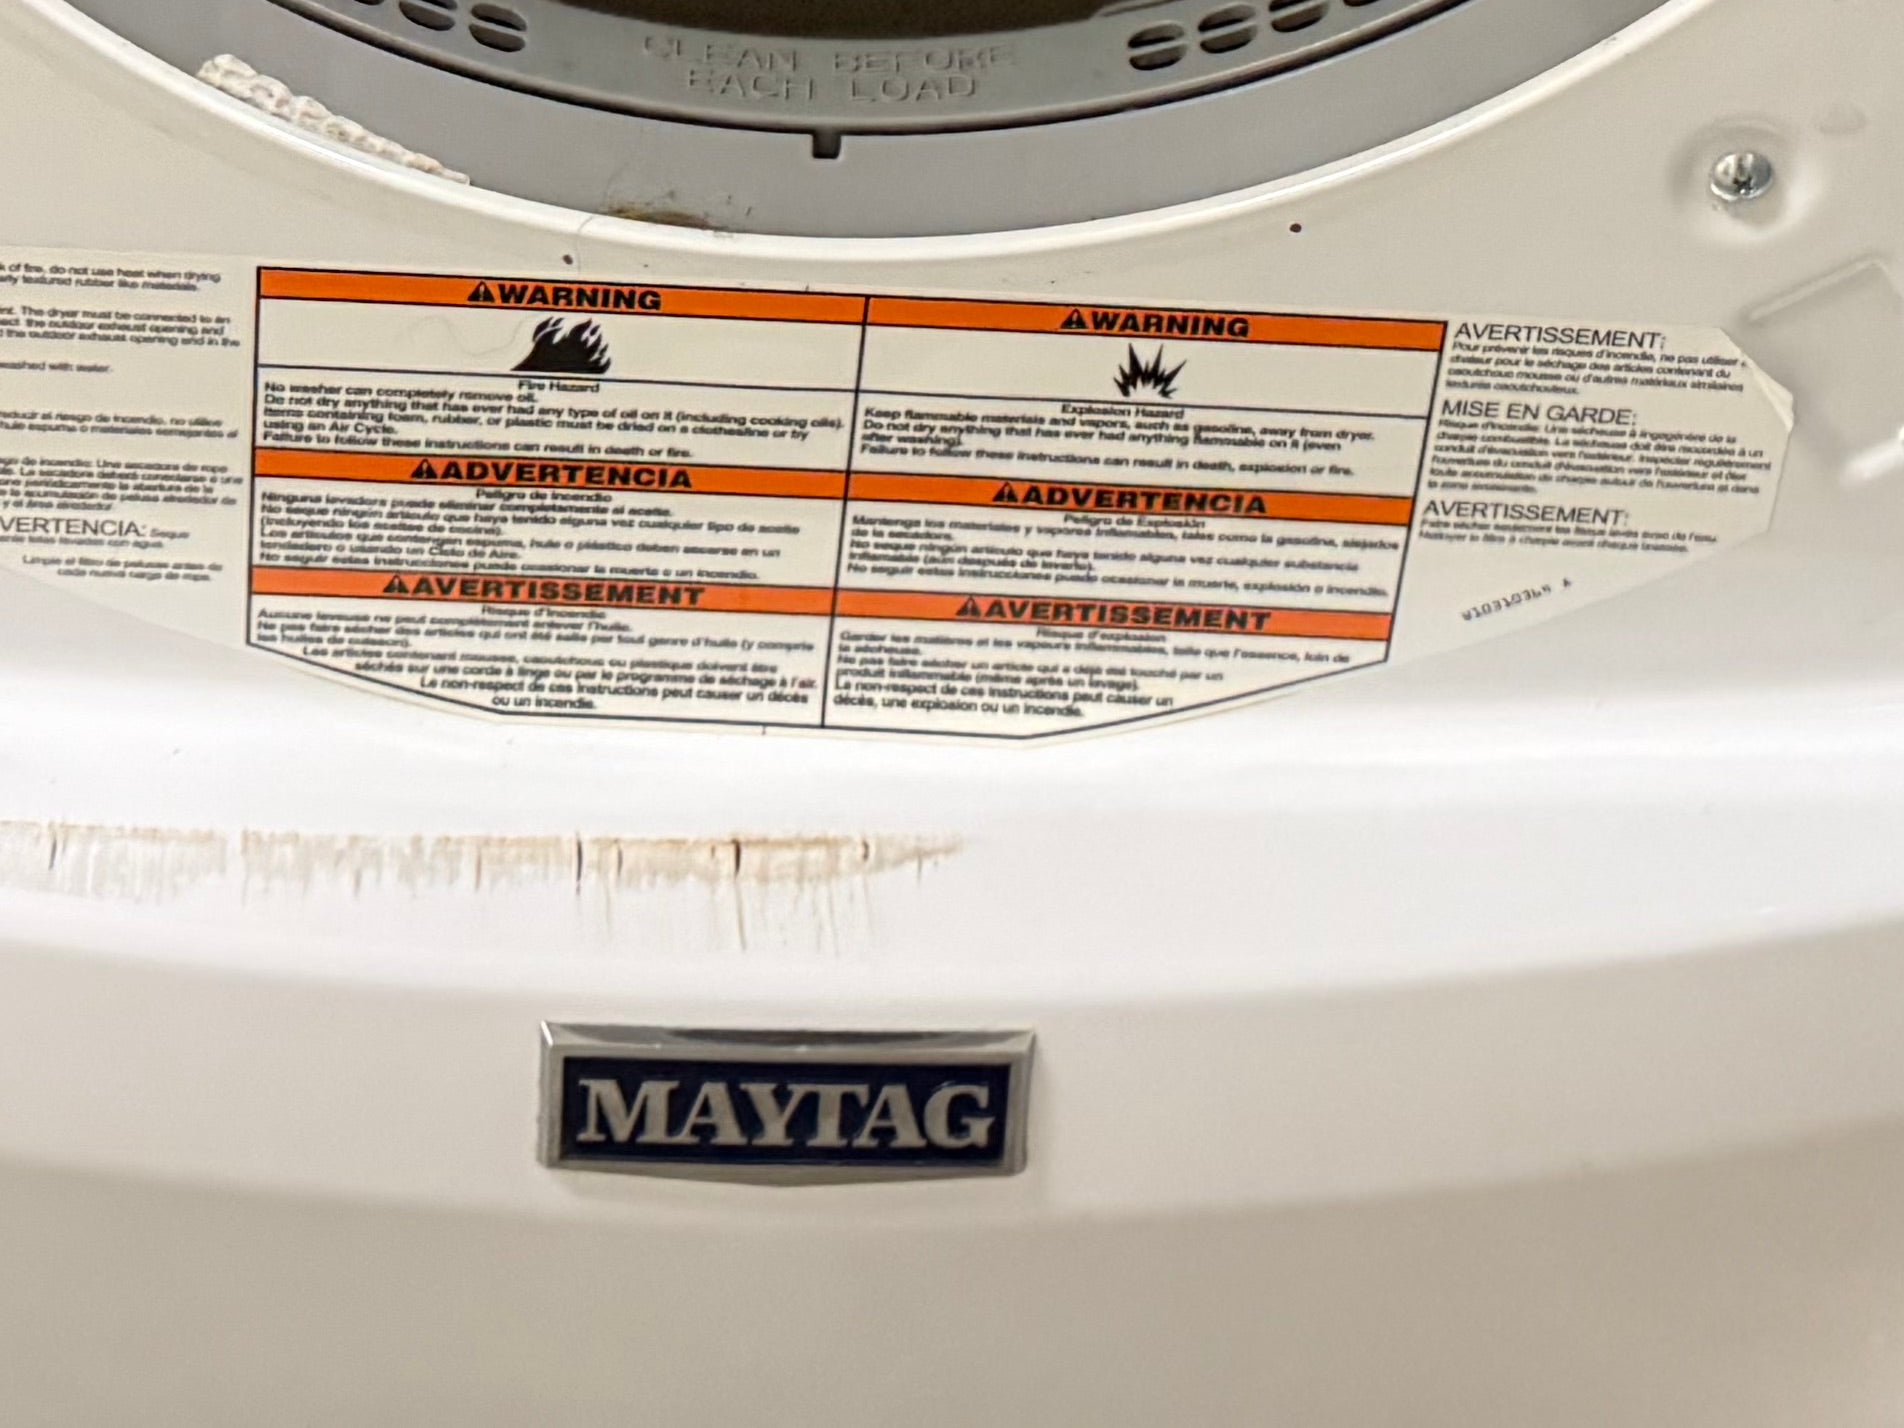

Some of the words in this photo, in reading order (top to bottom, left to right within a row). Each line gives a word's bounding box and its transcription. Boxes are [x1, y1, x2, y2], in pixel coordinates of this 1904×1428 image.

[644, 35, 798, 73] CLEAN
[833, 44, 1014, 74] BEFORE
[688, 67, 814, 101] EACH
[850, 73, 977, 103] LOAD
[498, 283, 663, 312] WARNING
[1091, 311, 1251, 338] WARNING
[1453, 321, 1668, 350] AVERTISSEMENT:
[1441, 398, 1500, 421] MISE
[1506, 401, 1541, 422] EN
[1546, 403, 1639, 428] GARDE:
[433, 461, 693, 490] ADVERTENCIA
[1020, 487, 1269, 515] ADVERTENCIA
[1422, 499, 1631, 527] AVERTISSEMENT:
[411, 577, 706, 607] AVERTISSEMENT
[985, 600, 1272, 632] AVERTISSEMENT
[576, 1078, 995, 1149] MAYTAG
